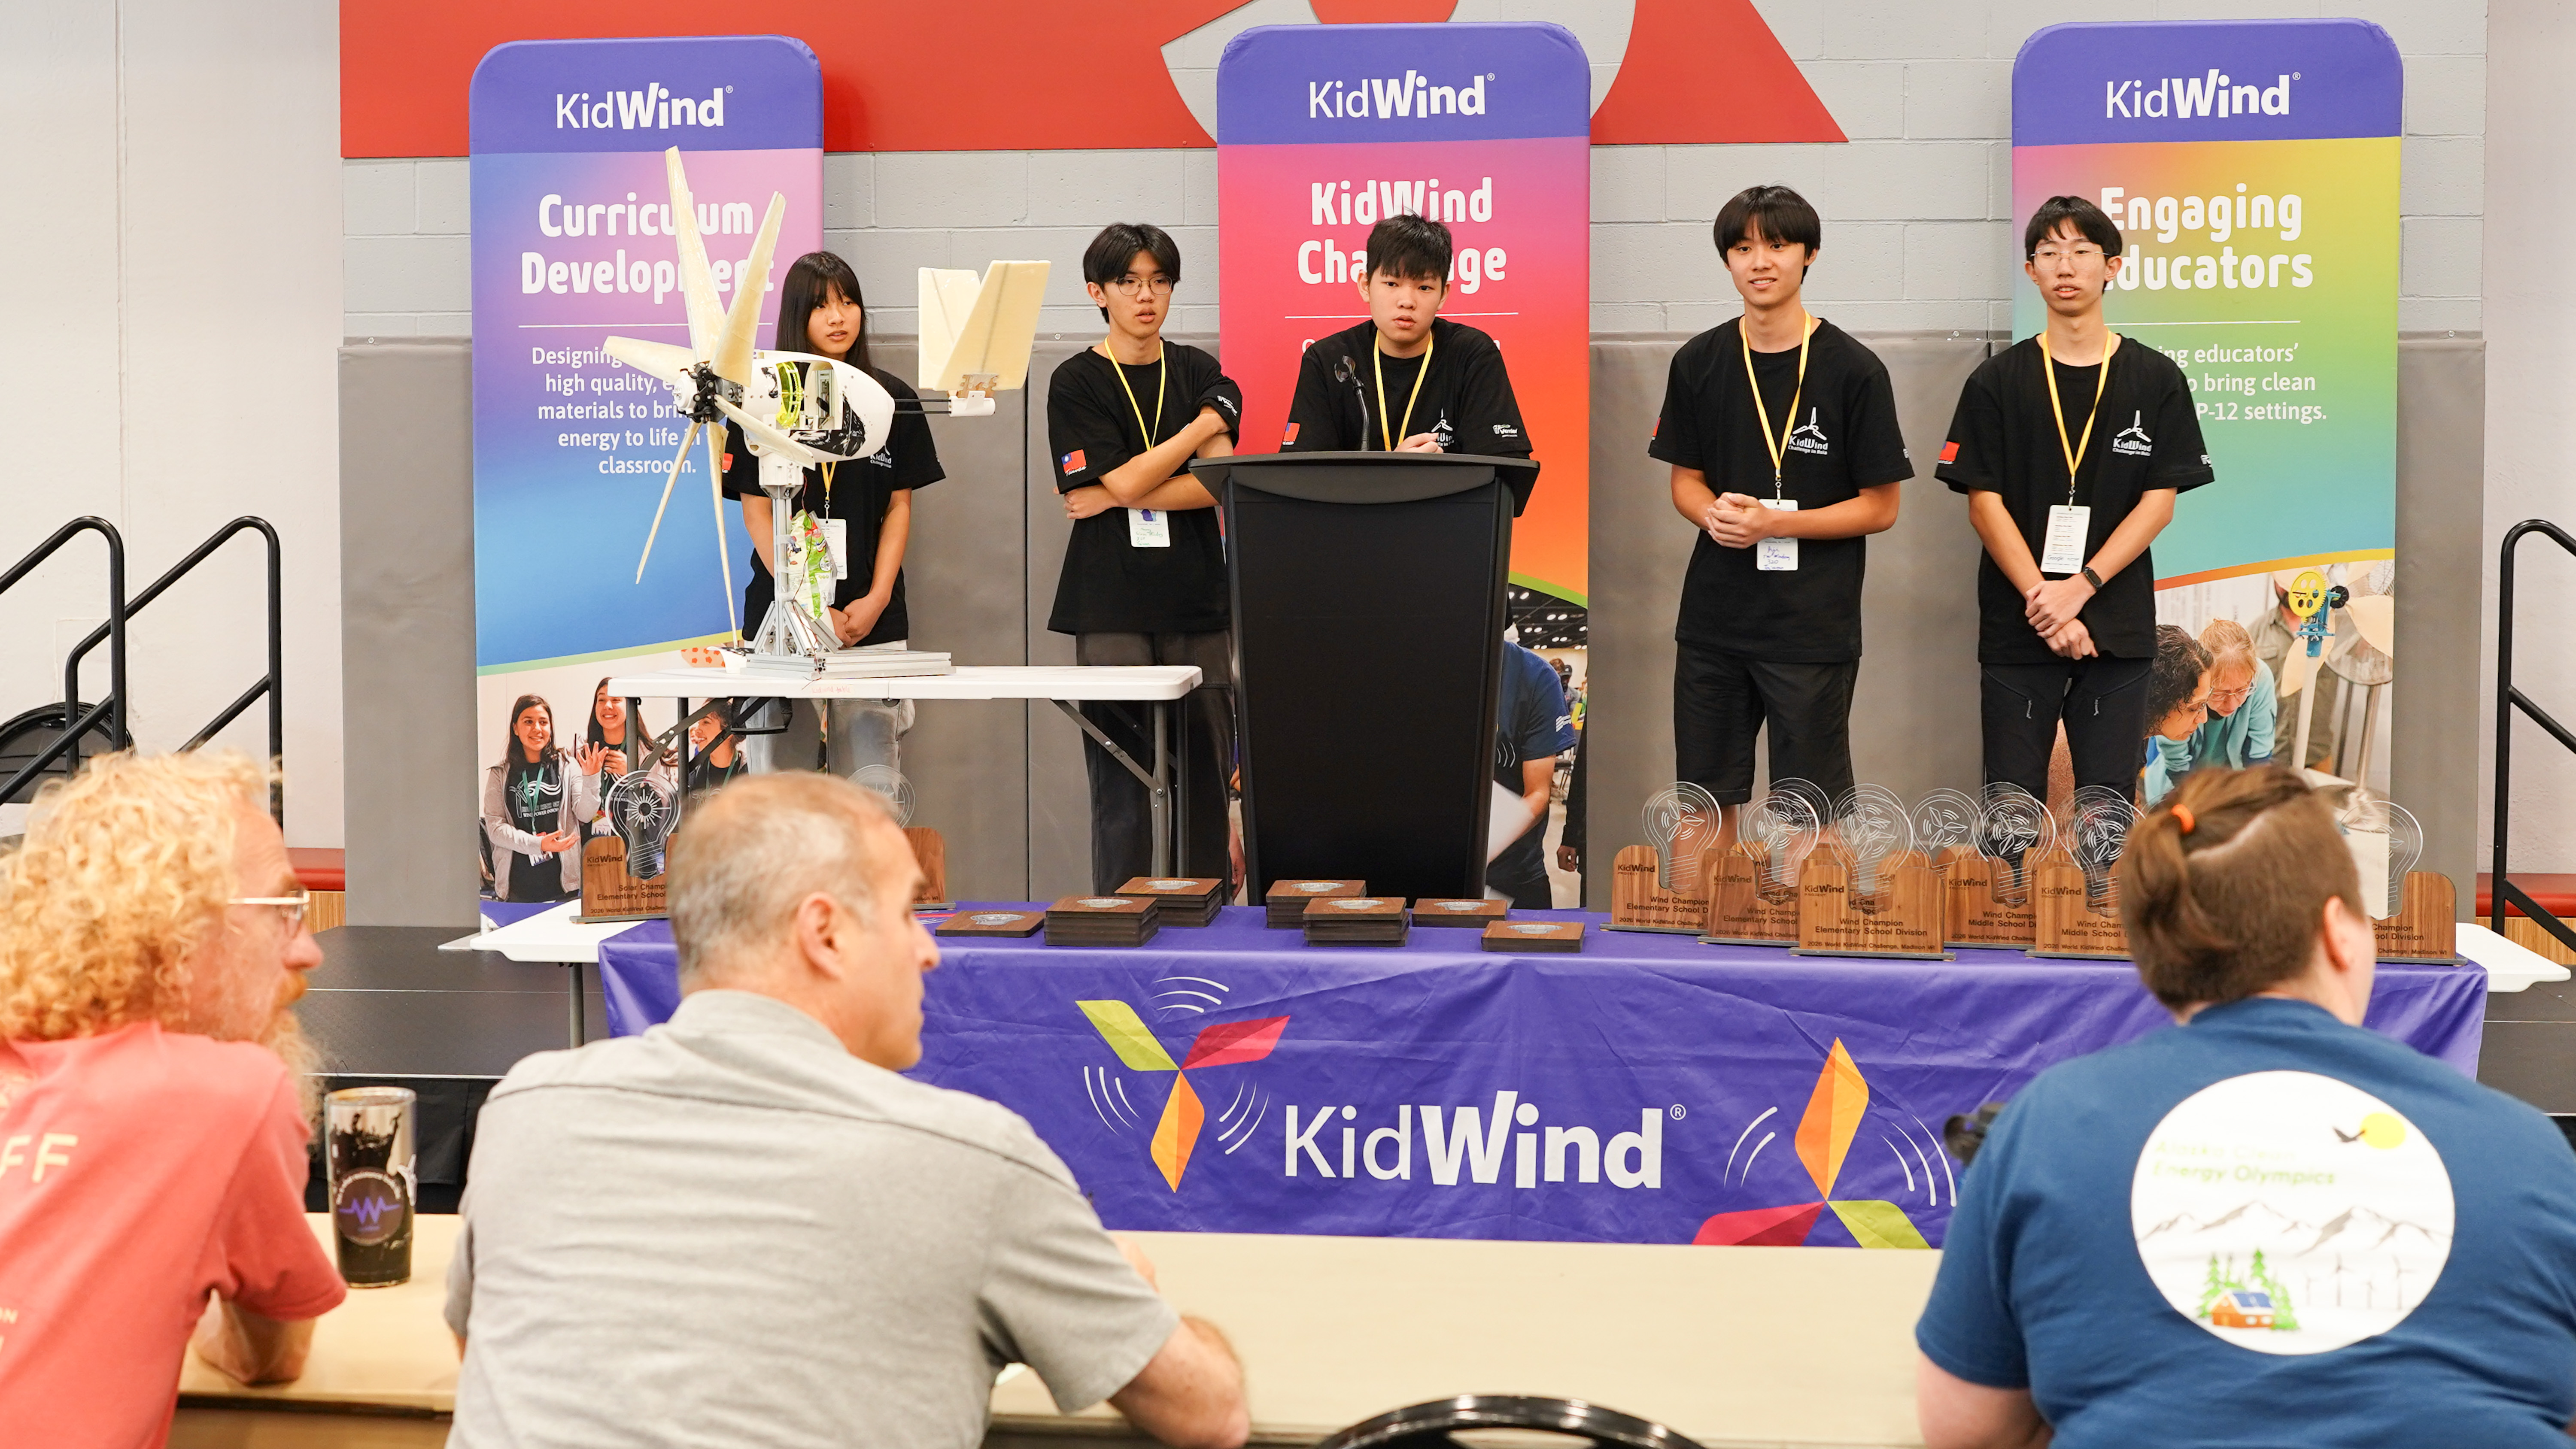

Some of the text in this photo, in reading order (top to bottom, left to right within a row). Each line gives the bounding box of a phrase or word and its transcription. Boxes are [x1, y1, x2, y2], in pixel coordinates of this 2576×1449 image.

[1311, 176, 1492, 225] KidWind
[2101, 183, 2302, 243] Engaging
[1297, 239, 1507, 294] Chage
[2105, 244, 2313, 291] ducators
[546, 373, 585, 396] high
[590, 373, 657, 396] quality,
[2204, 373, 2257, 396] bring
[2262, 372, 2316, 391] clean
[538, 400, 624, 419] materials
[629, 402, 647, 419] to
[2196, 401, 2327, 425] P-12 settings.
[558, 432, 620, 451] energy
[625, 430, 644, 446] to
[649, 427, 679, 446] life
[1789, 435, 1829, 450] KidWind
[2113, 438, 2152, 452] KidWind
[586, 854, 623, 863] KidWind
[1618, 864, 1655, 872] KidWind
[1714, 874, 1752, 883] KidWind
[1949, 878, 1987, 887] KidWind
[640, 883, 665, 892] Champ
[1804, 884, 1844, 893] KidWind
[2041, 886, 2082, 895] KidWind
[1627, 903, 1669, 912] Elementary
[1723, 915, 1767, 925] Elementary
[1863, 919, 1903, 927] Champion
[1815, 926, 1860, 935] Elementary
[2372, 923, 2413, 932] Champion
[2152, 1160, 2336, 1186] Energy Olympics
